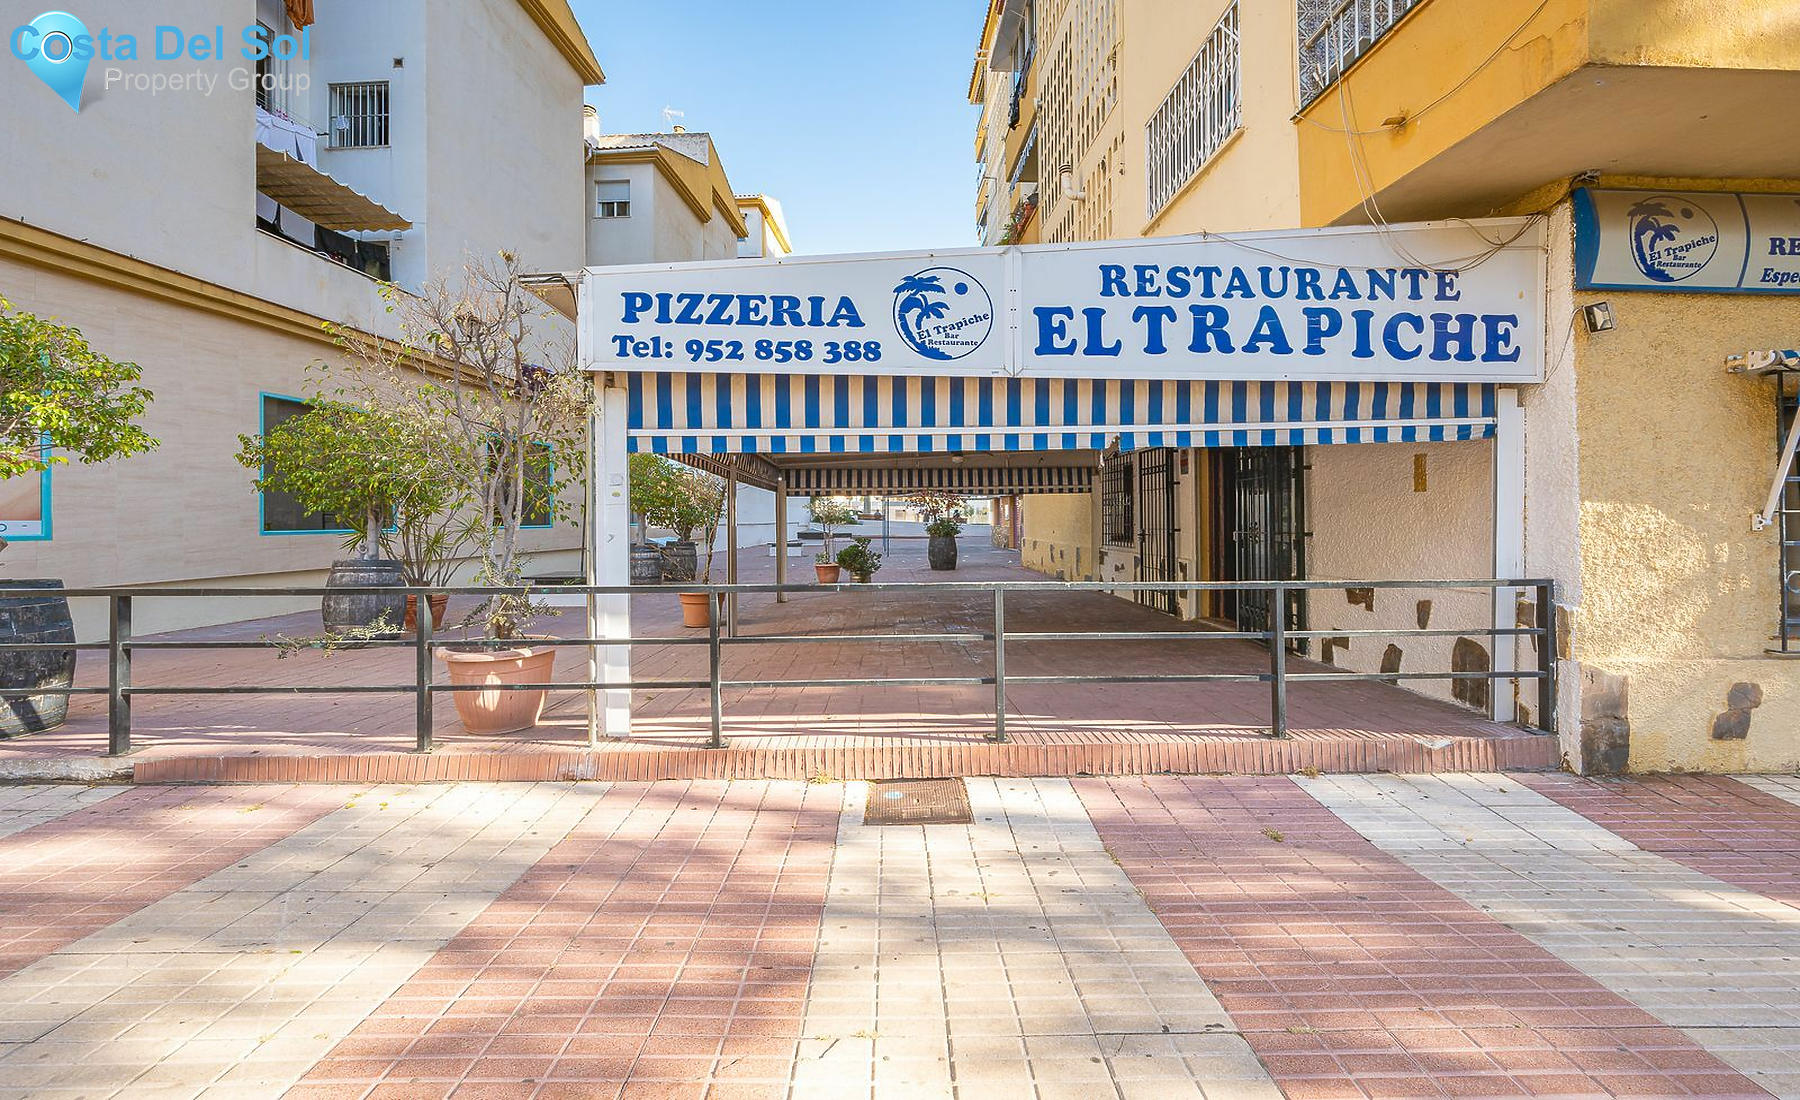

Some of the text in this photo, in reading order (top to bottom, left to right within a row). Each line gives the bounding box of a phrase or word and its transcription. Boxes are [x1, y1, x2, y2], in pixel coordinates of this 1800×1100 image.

[1649, 235, 1716, 262] El Trapiche
[1656, 261, 1702, 269] Restaurante
[1760, 267, 1800, 286] Espe
[1099, 264, 1462, 301] RESTAURANTE
[620, 292, 867, 328] PIZZERIA
[917, 313, 990, 340] El Trapiche
[1033, 304, 1522, 364] EL TRAPICHE
[611, 334, 883, 364] Tel: 952 858 388
